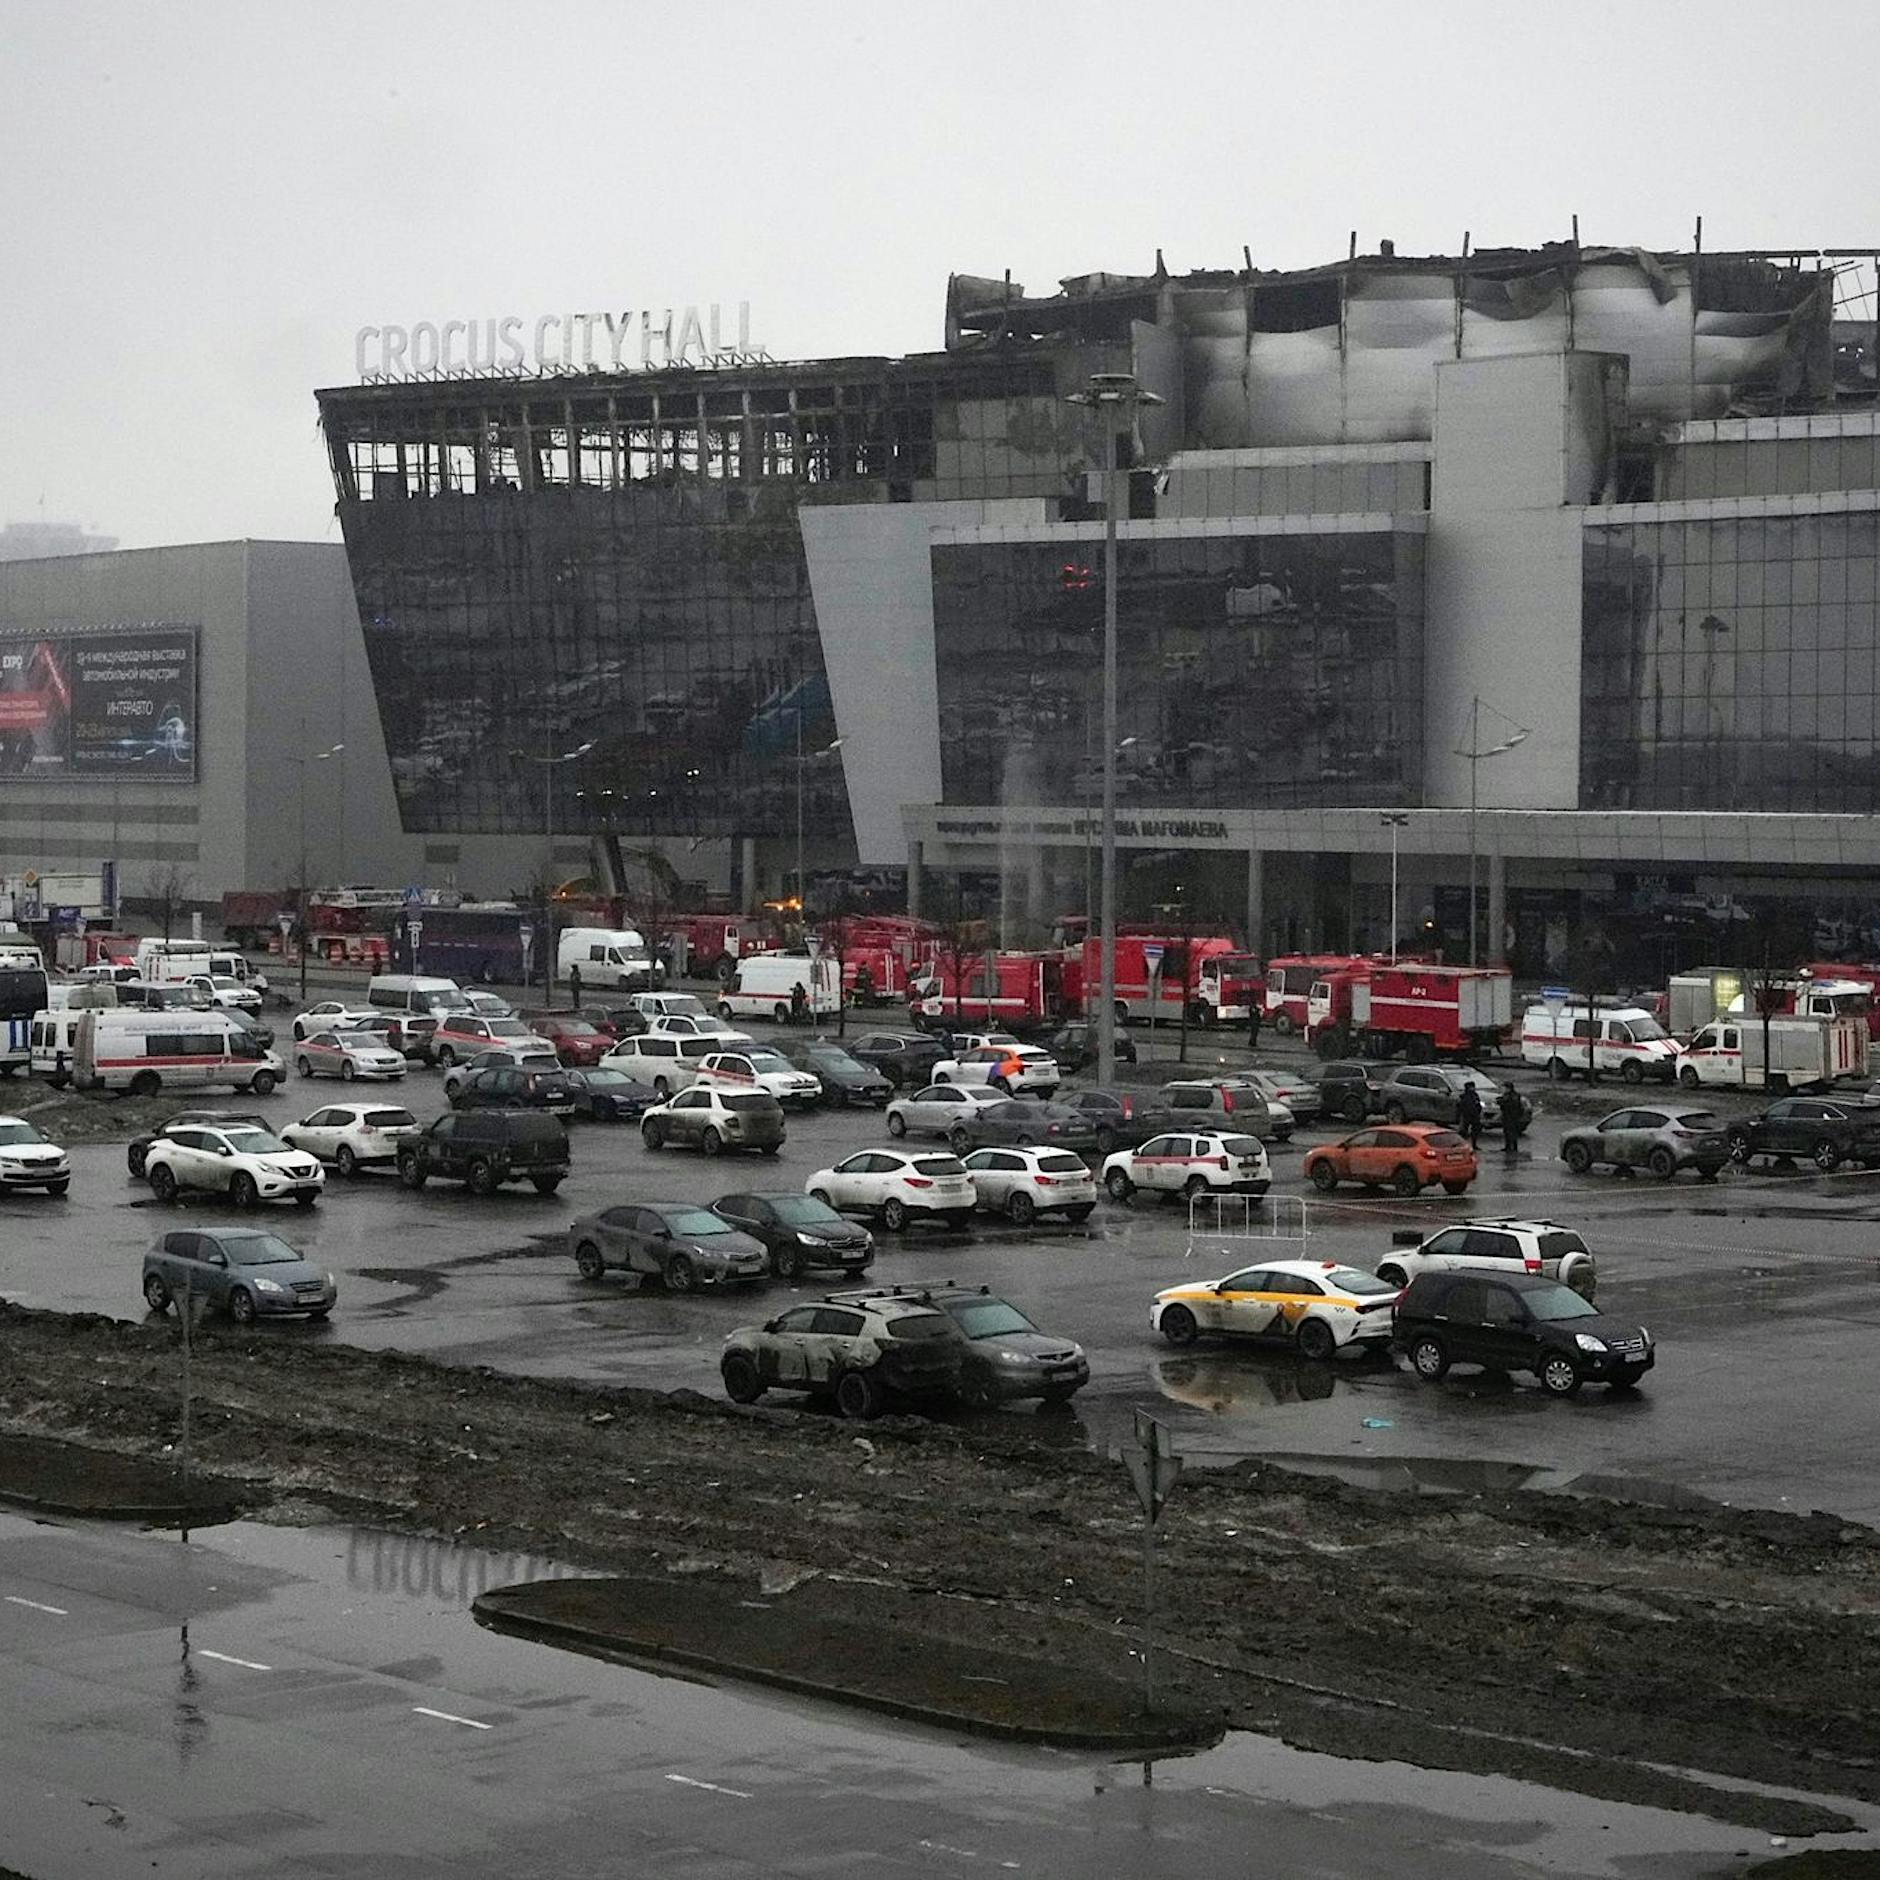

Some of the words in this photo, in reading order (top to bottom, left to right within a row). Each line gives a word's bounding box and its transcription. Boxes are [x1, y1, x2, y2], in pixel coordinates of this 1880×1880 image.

[355, 316, 524, 375] CROCUS
[534, 311, 632, 367] CITY
[640, 300, 766, 363] HALL
